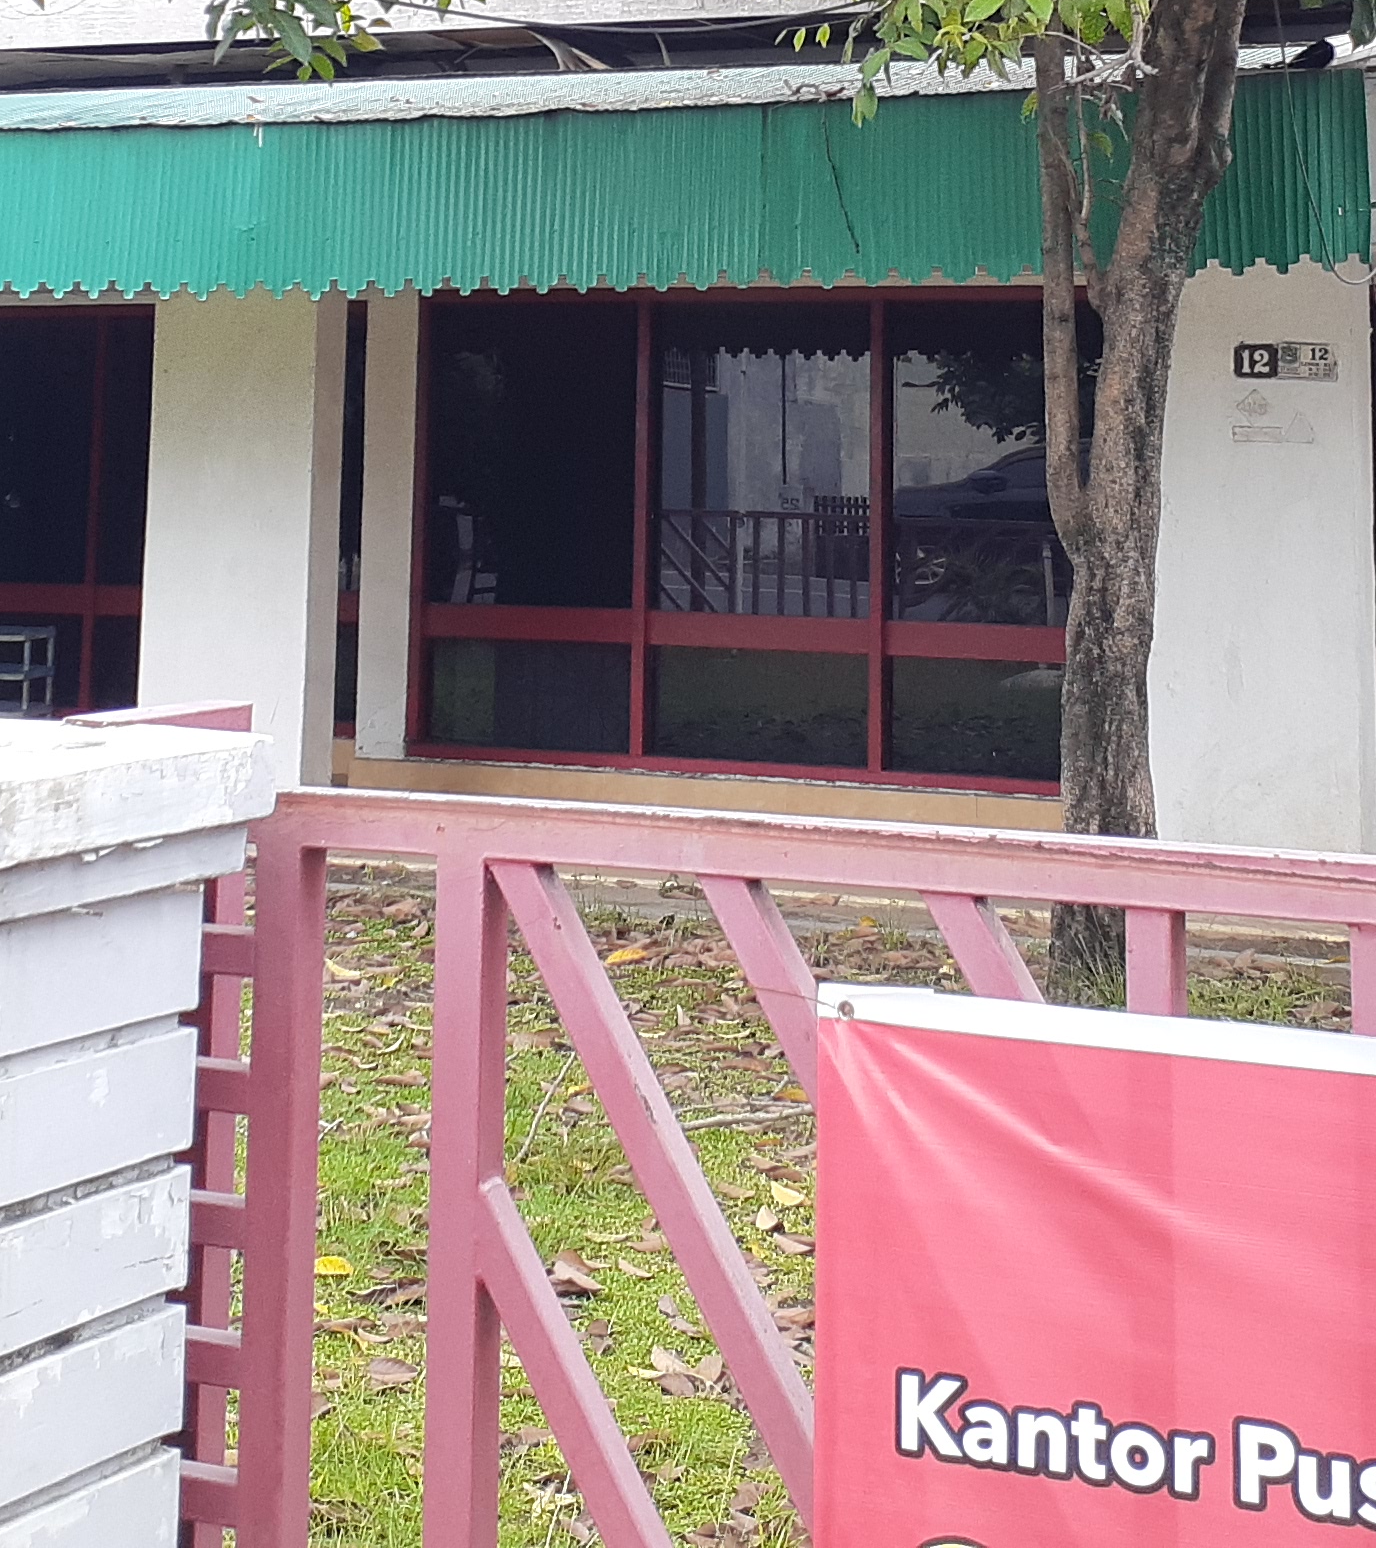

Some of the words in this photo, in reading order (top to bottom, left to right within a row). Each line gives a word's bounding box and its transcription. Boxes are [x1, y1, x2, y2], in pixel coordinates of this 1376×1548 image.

[1240, 349, 1270, 374] 12
[1310, 347, 1329, 362] 12
[896, 1370, 1212, 1498] Kantor
